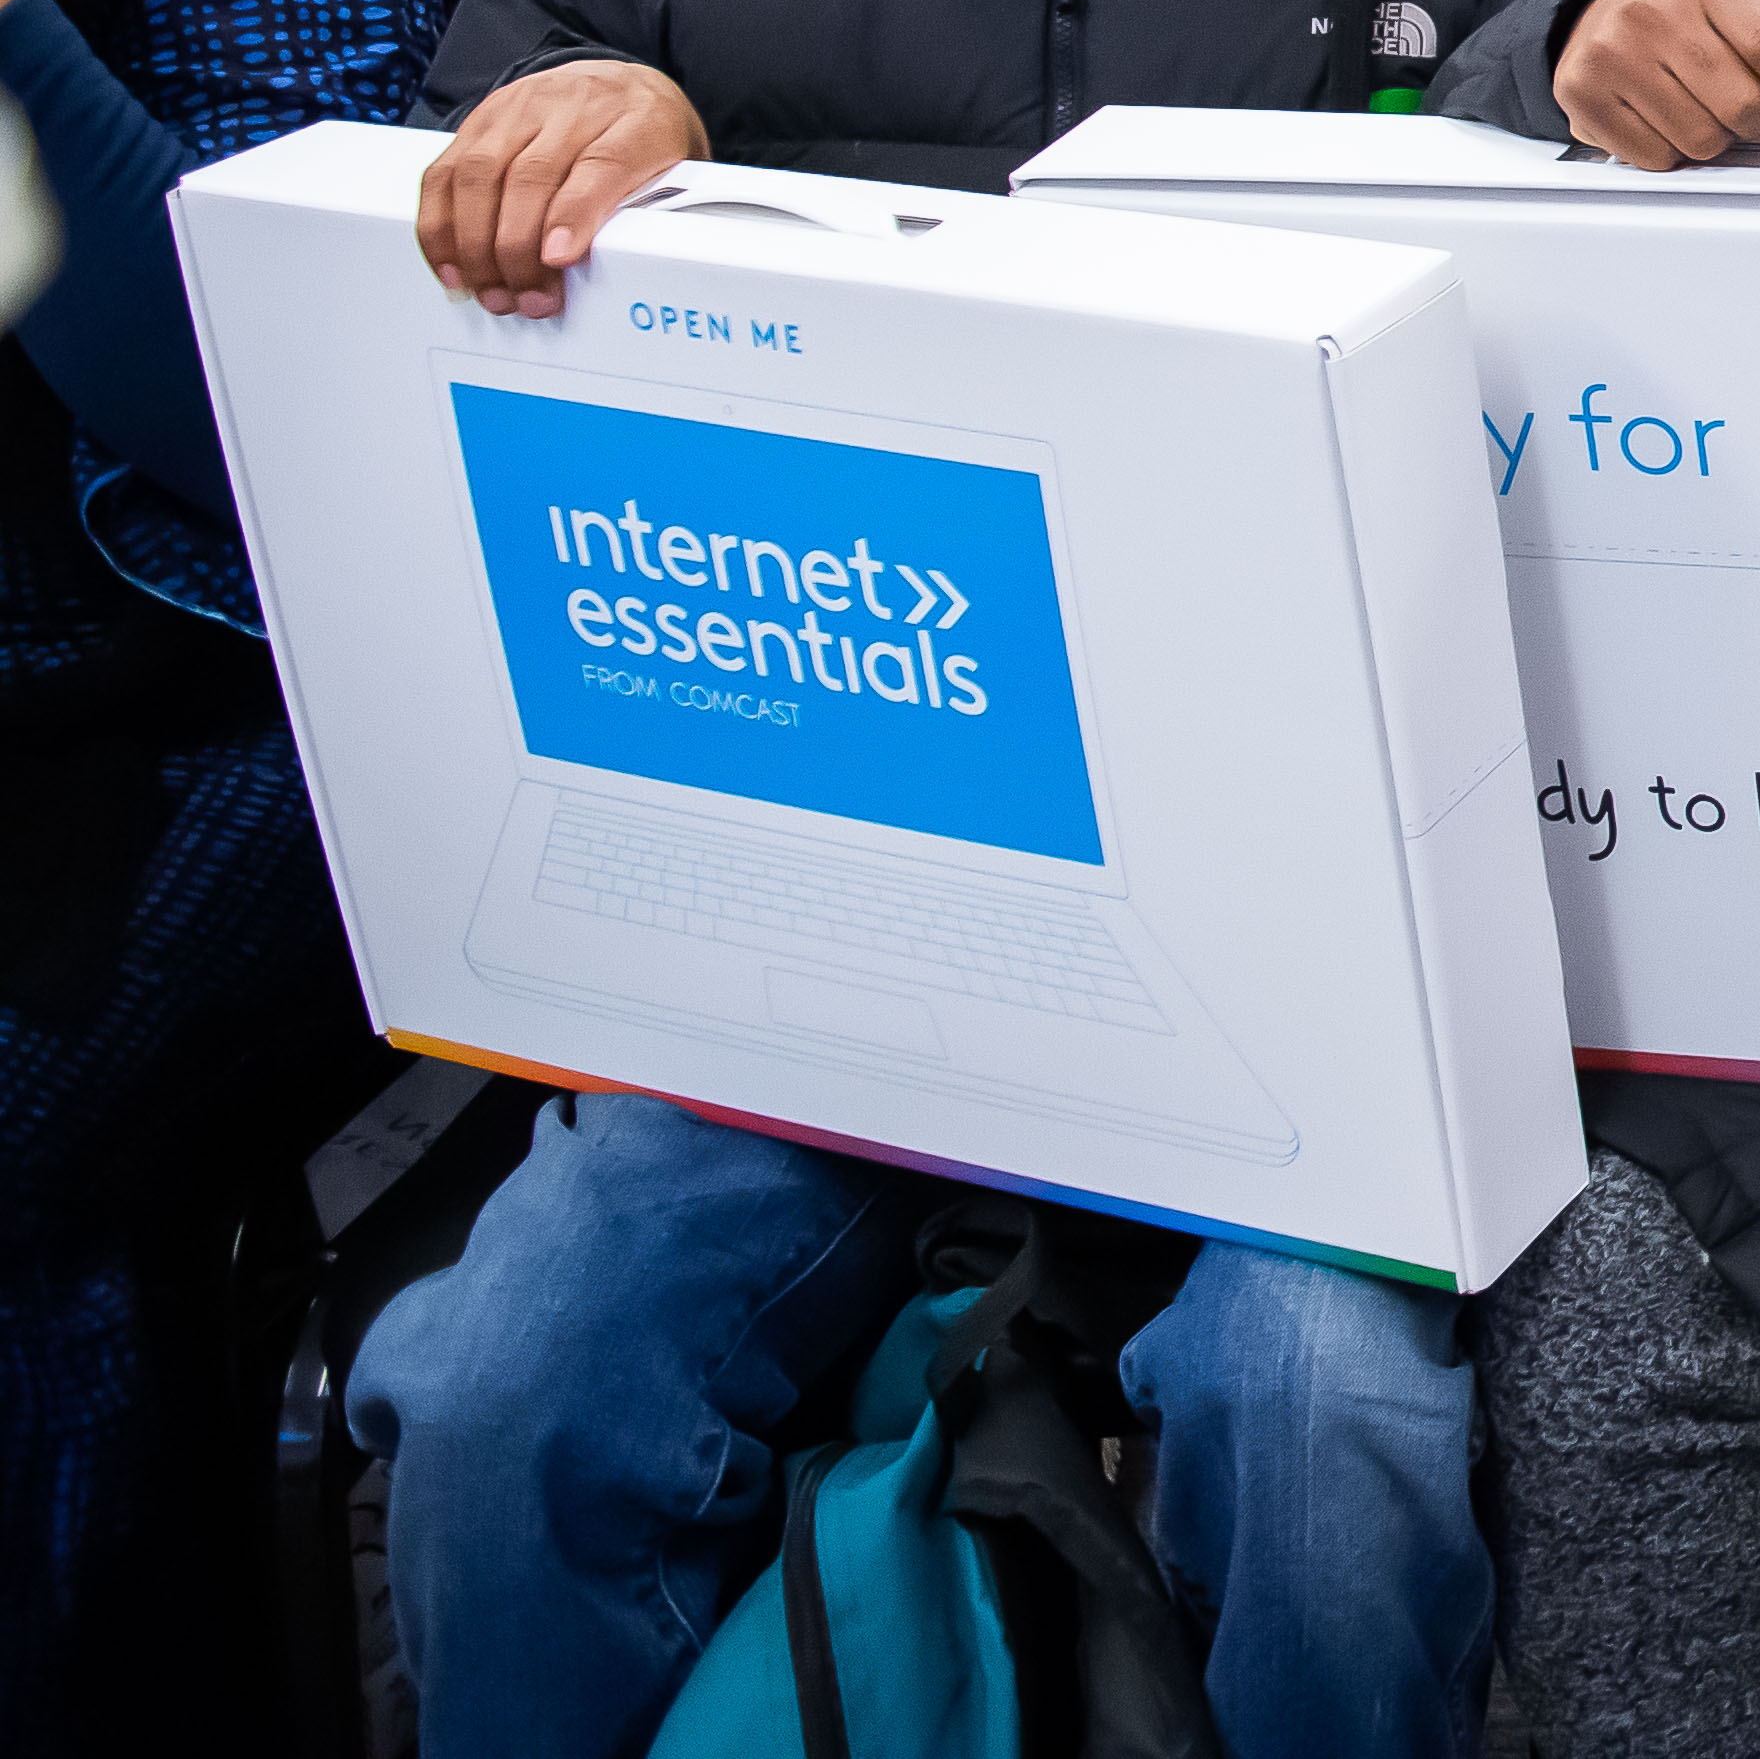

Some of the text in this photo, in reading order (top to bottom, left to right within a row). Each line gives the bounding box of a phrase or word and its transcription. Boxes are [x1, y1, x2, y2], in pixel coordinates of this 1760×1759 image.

[630, 302, 802, 354] OPEN ME
[1569, 384, 1724, 476] for
[550, 497, 893, 622] internet
[567, 586, 988, 717] essentials
[582, 664, 800, 728] FROM COMCAST
[1648, 776, 1725, 832] to
